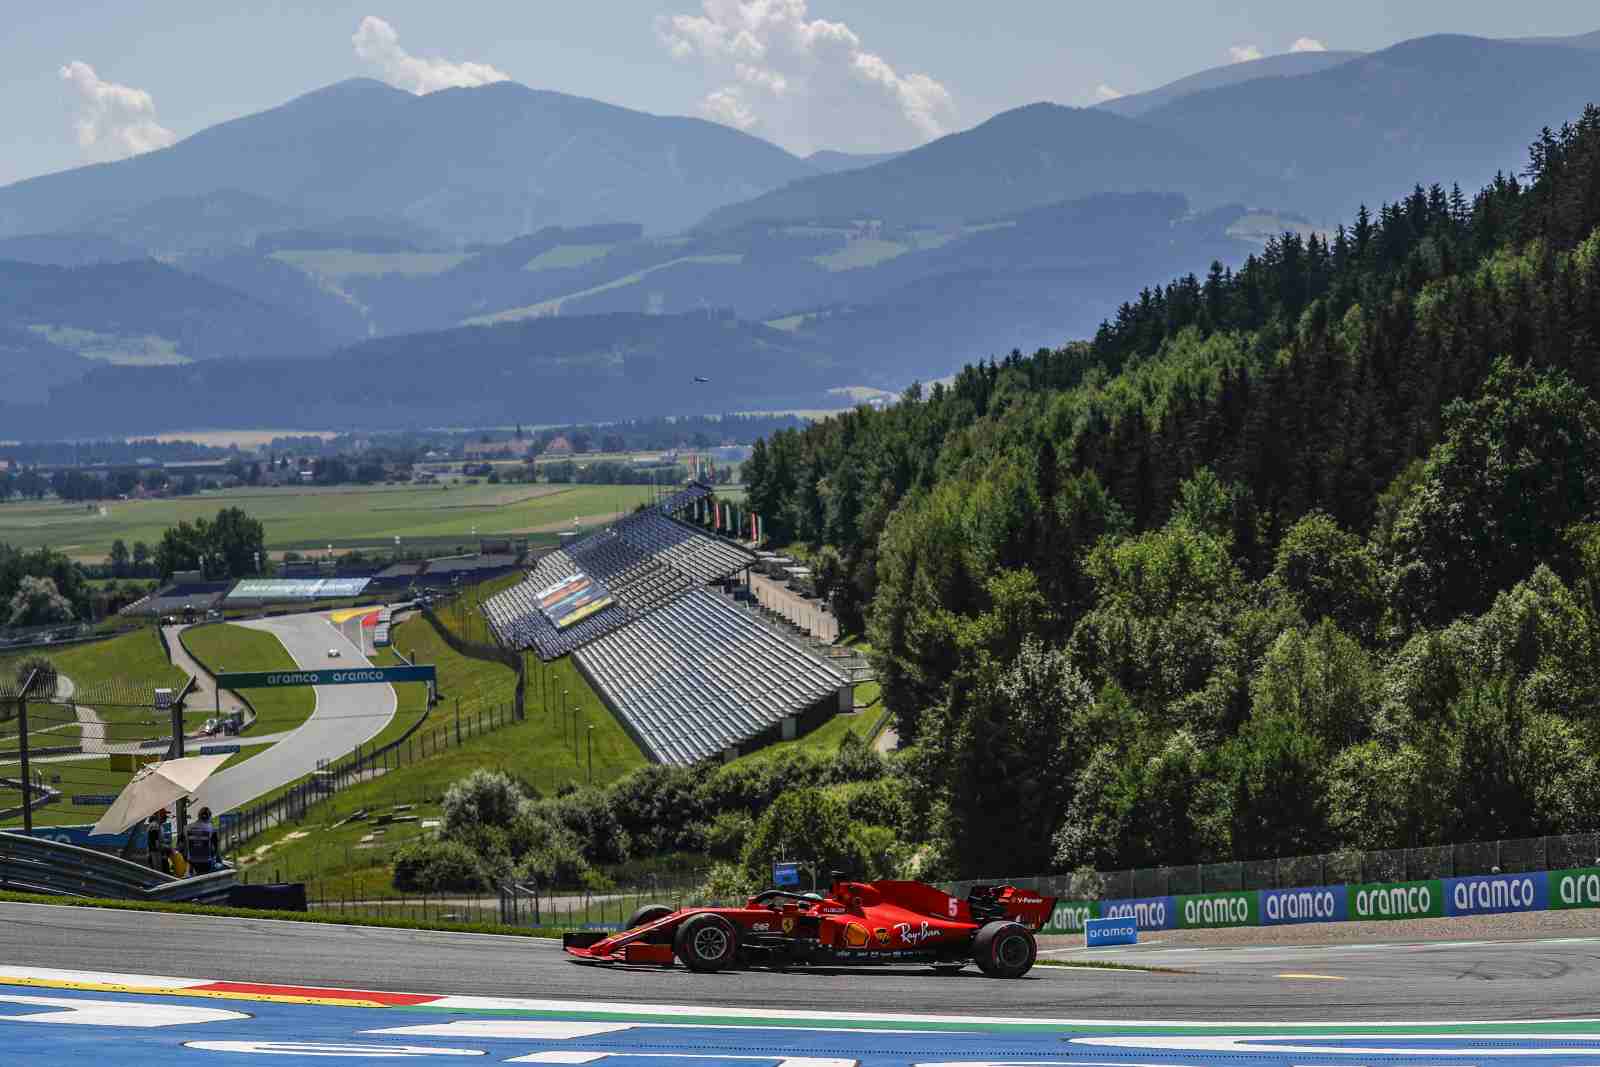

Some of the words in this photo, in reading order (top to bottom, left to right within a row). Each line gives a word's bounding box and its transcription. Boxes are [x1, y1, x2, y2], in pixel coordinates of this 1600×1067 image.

[267, 673, 319, 685] aramco
[332, 671, 384, 681] aramco
[948, 897, 958, 917] 5
[1266, 891, 1335, 919] aramco
[1356, 886, 1431, 916] aramco
[1454, 879, 1534, 910] aramco
[1184, 897, 1249, 924] aramco
[893, 920, 942, 944] Ray-Ban
[1089, 926, 1134, 938] aramco
